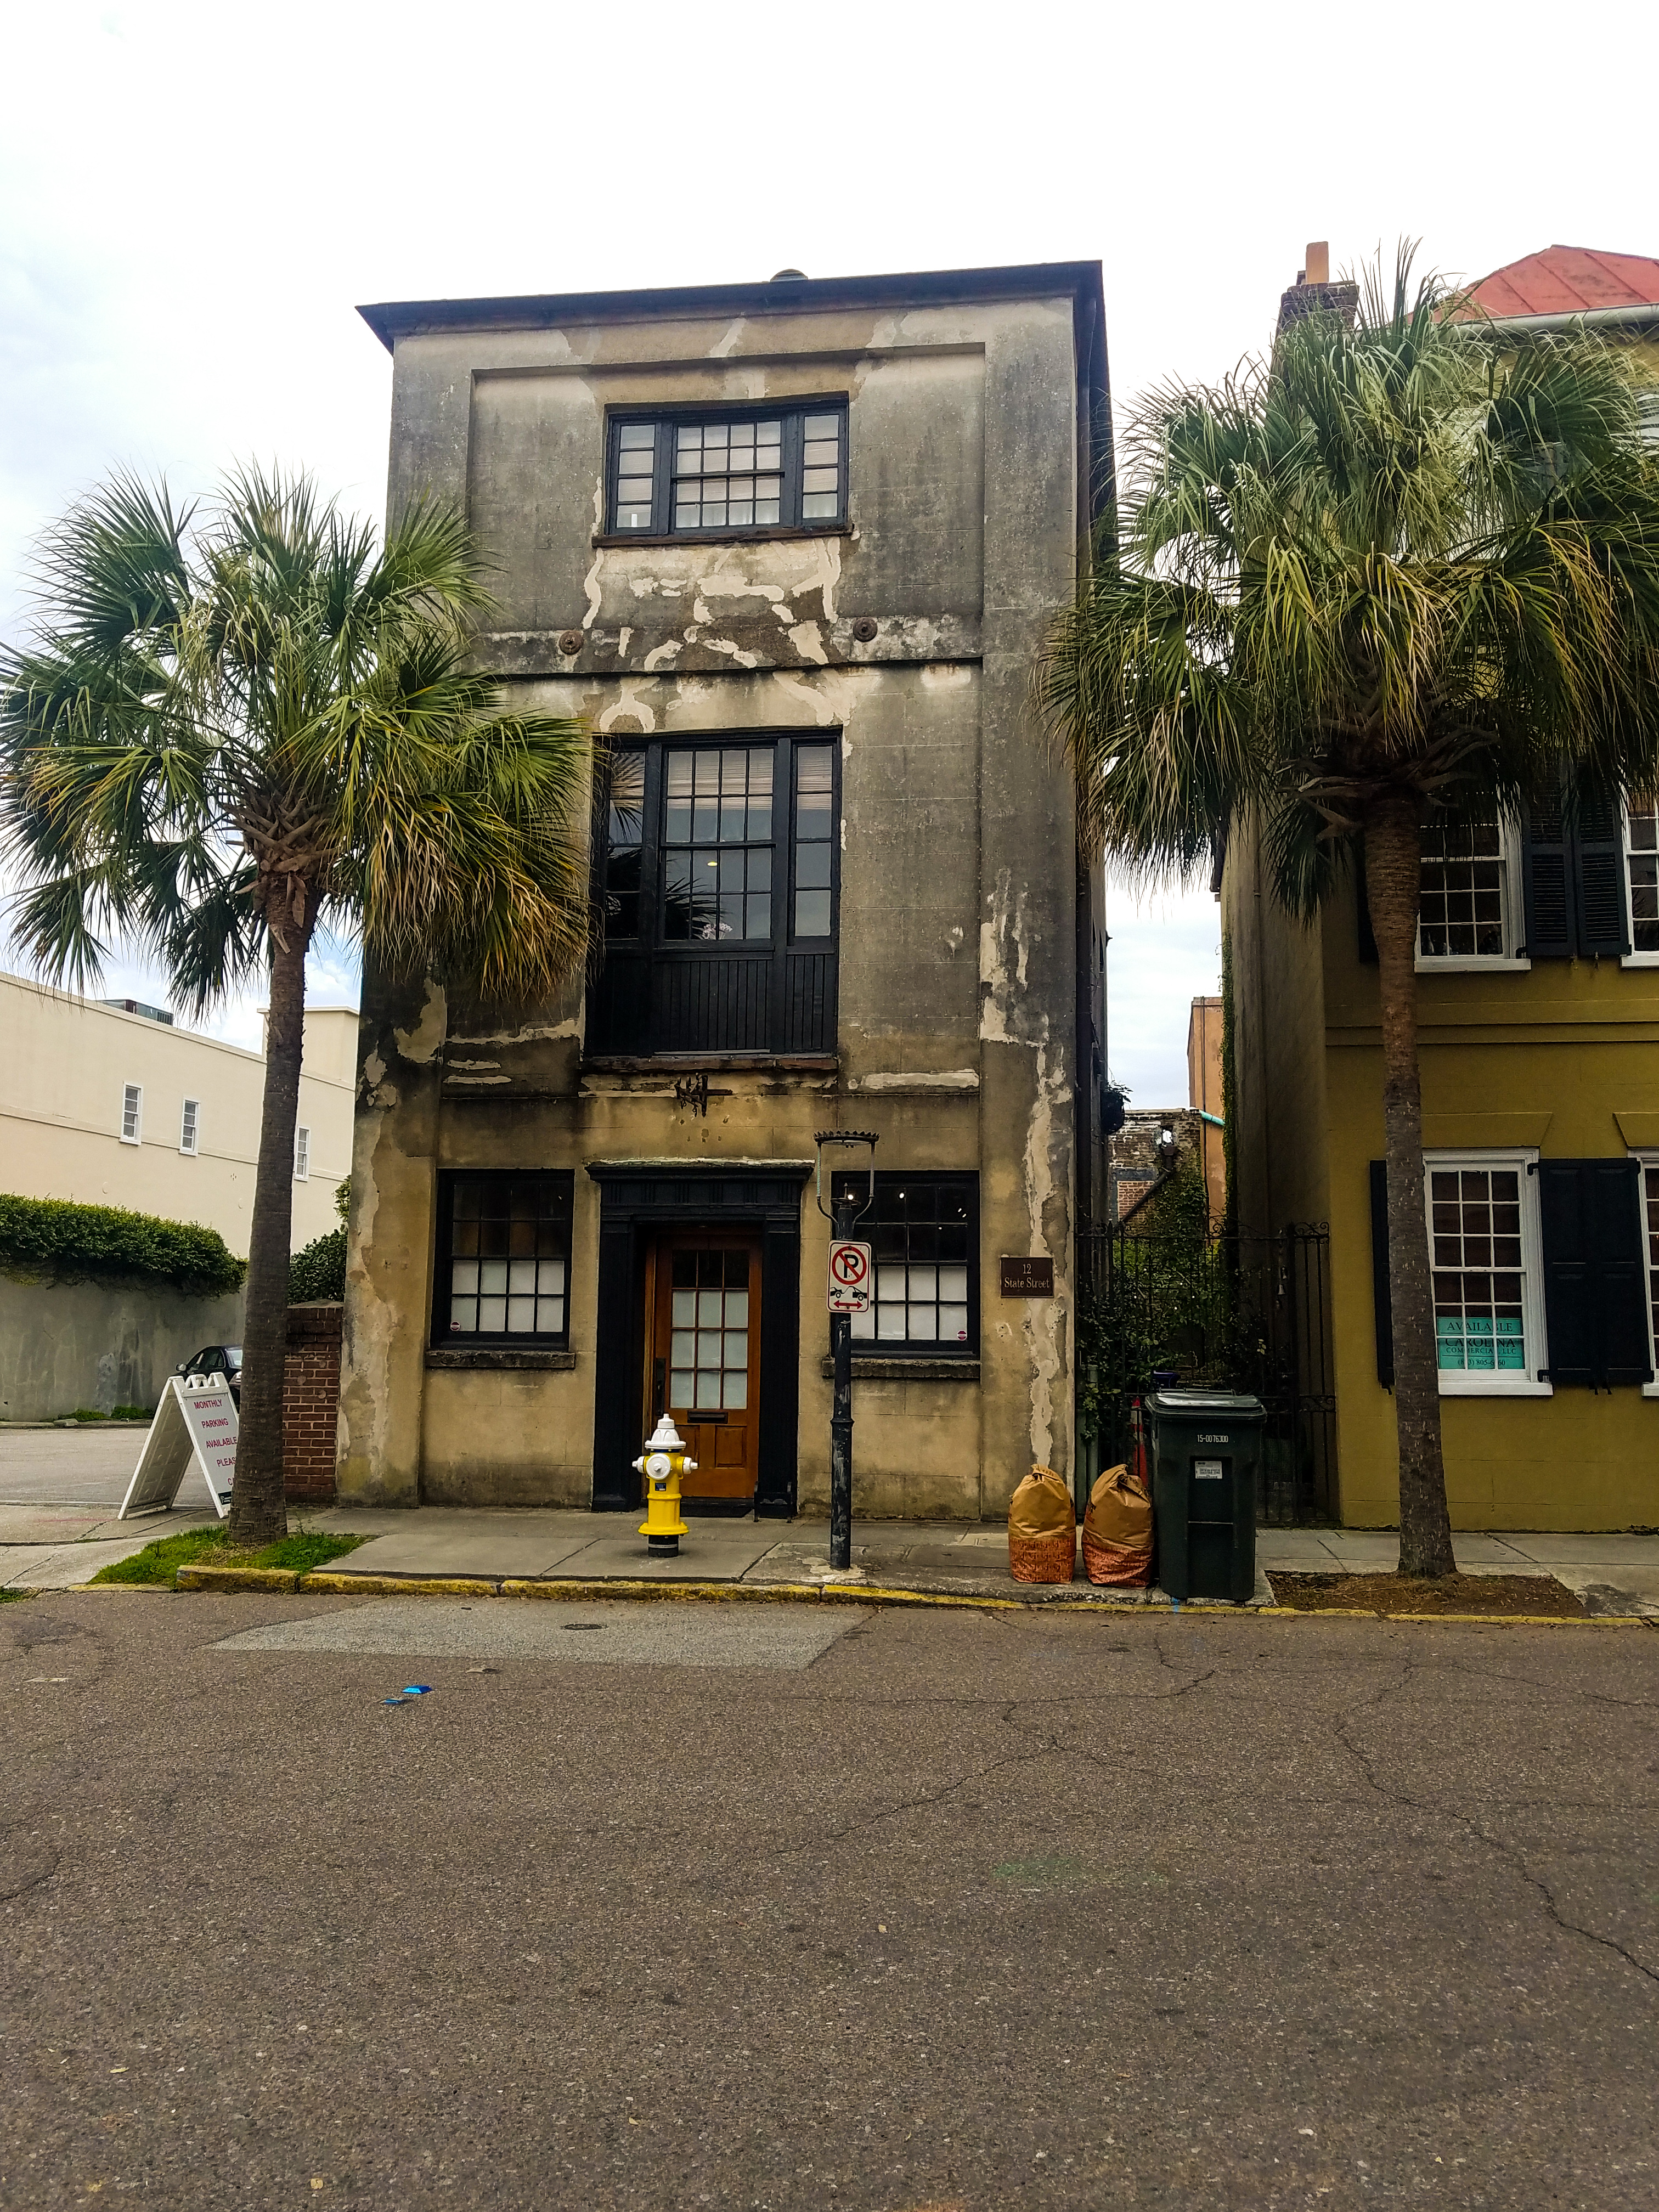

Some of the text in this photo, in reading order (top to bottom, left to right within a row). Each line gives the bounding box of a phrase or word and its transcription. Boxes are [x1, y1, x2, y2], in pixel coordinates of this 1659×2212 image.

[1023, 1263, 1031, 1274] 12
[1004, 1277, 1049, 1288] State Street
[194, 1399, 222, 1409] MONTHLY
[201, 1418, 228, 1429] PARKING
[206, 1436, 238, 1448] AVAILABLE
[217, 1457, 236, 1467] PLEAS
